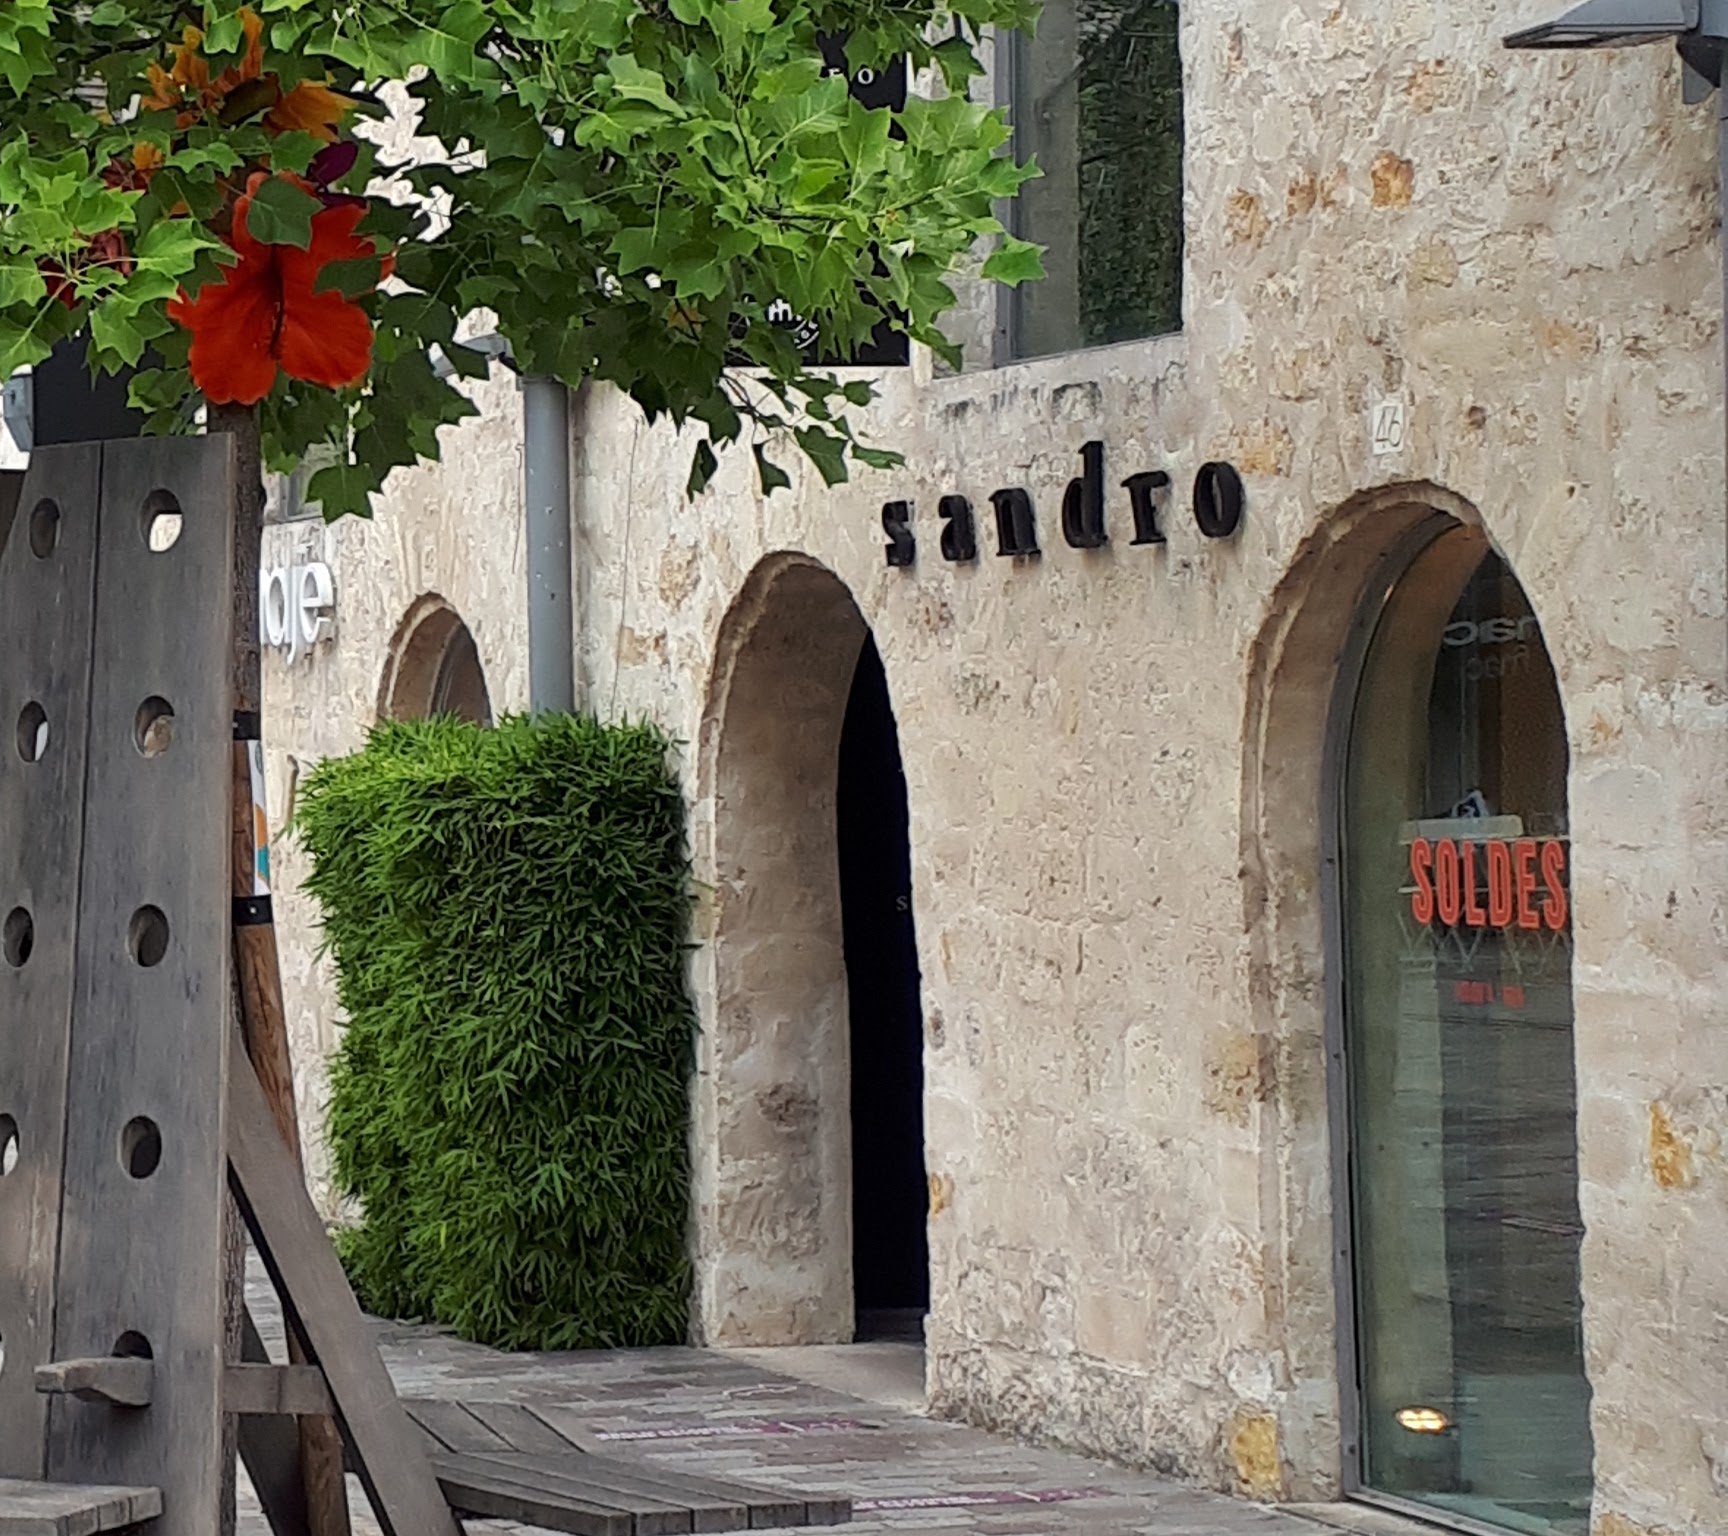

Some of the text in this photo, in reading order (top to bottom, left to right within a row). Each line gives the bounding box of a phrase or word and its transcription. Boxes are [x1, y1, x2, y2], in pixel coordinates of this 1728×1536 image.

[1375, 405, 1401, 447] 46
[882, 440, 1243, 566] sandro
[259, 562, 334, 665] aje
[1410, 836, 1568, 930] SOLDES
